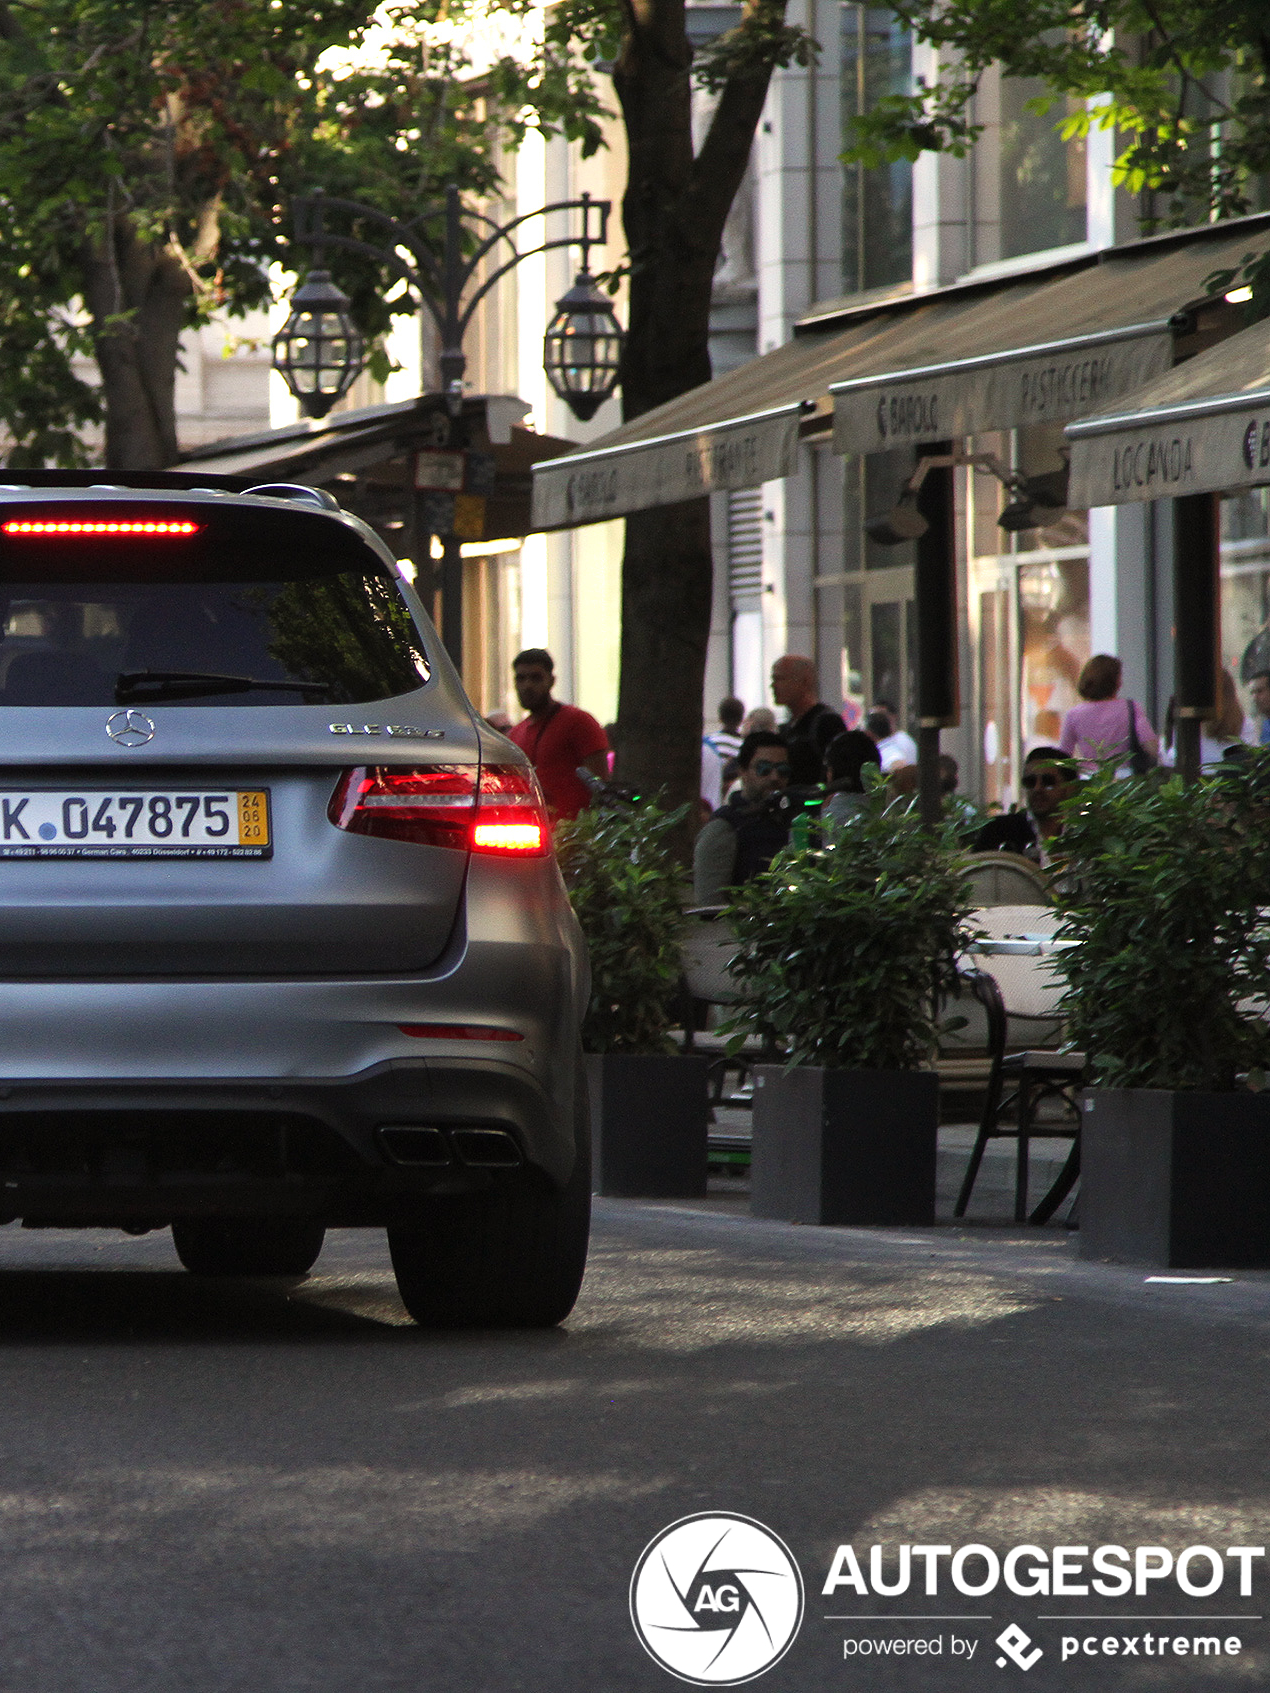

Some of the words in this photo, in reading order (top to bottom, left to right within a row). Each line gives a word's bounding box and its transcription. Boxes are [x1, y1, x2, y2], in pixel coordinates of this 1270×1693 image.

[1113, 437, 1193, 490] LOCANDA
[329, 723, 382, 735] GLC
[241, 795, 260, 808] 24
[1, 797, 31, 840] K
[62, 795, 230, 840] 047875
[243, 825, 261, 838] 20
[81, 847, 109, 856] German
